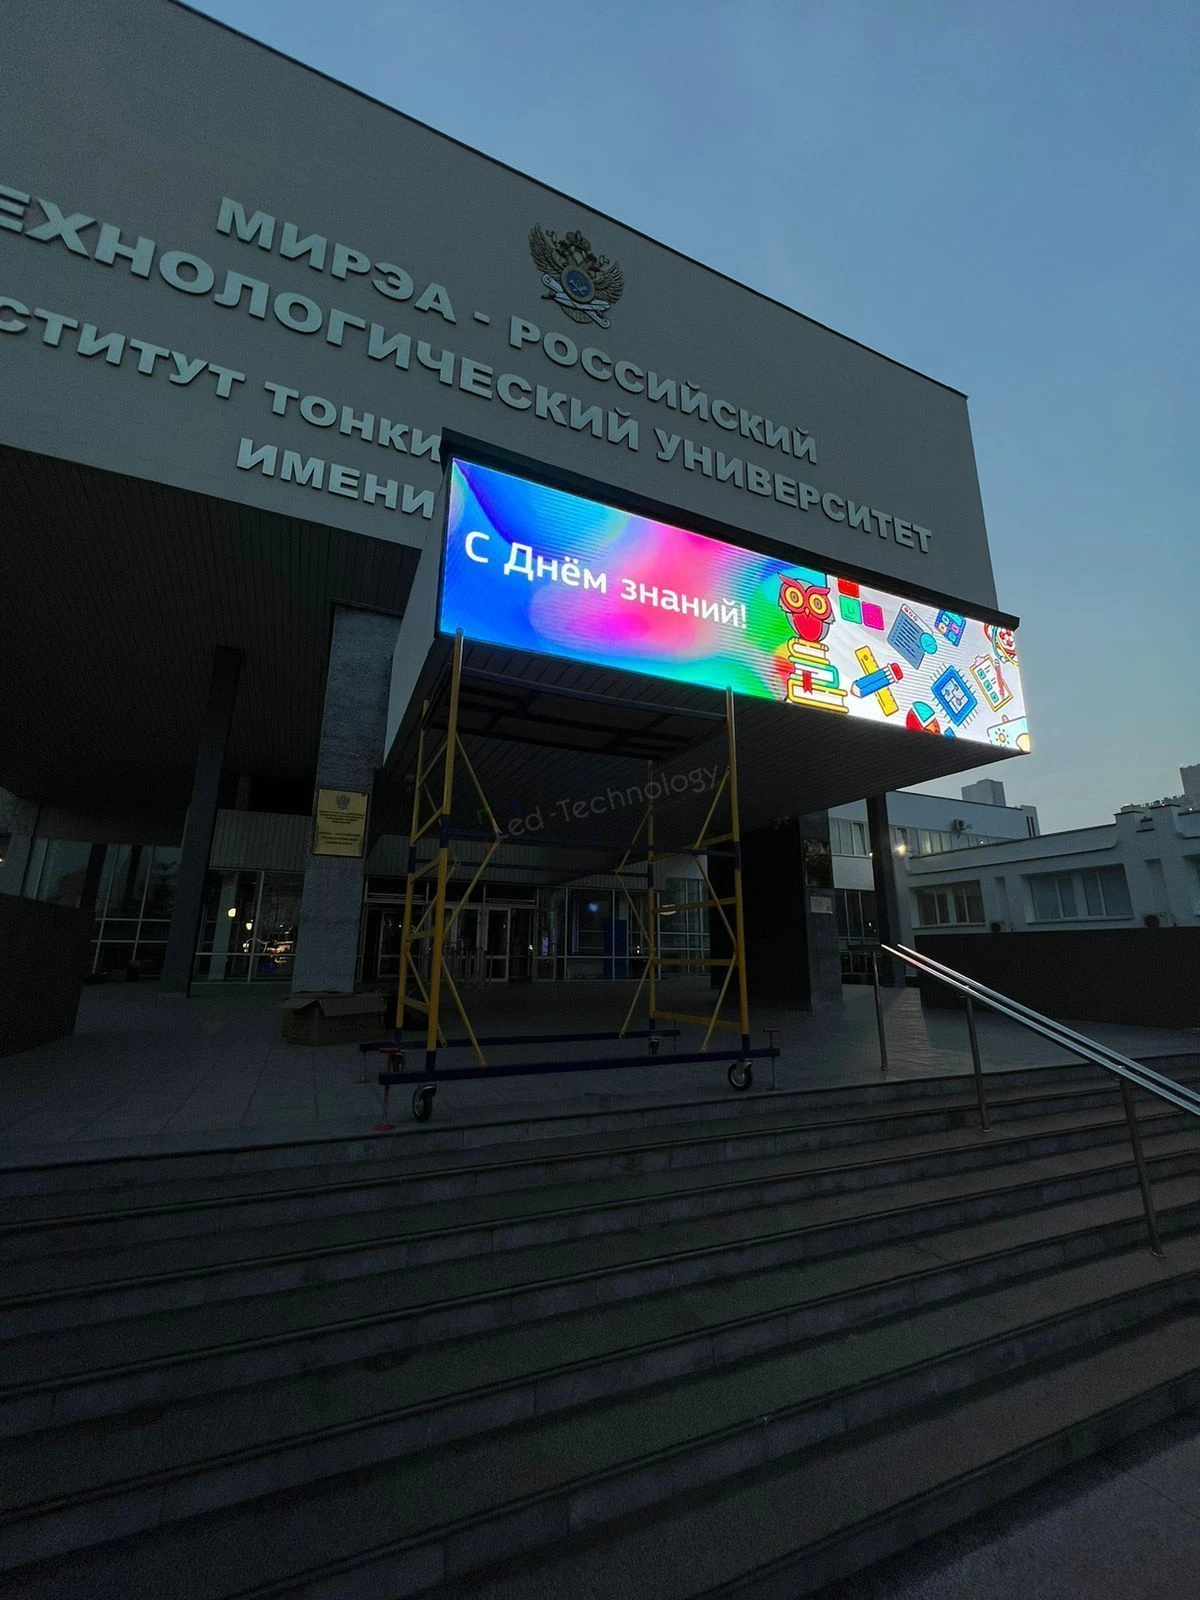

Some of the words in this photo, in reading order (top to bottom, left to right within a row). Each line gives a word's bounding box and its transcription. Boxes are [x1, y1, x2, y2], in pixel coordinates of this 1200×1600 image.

[216, 197, 457, 324] МИРЭА
[508, 315, 818, 465] РОССИЙСКИЙ
[236, 437, 435, 520] ИМЕНИ
[654, 427, 933, 554] УНИВЕРСИТЕТ
[464, 531, 490, 564] С
[503, 541, 608, 594] Днём
[620, 575, 748, 630] знаний!
